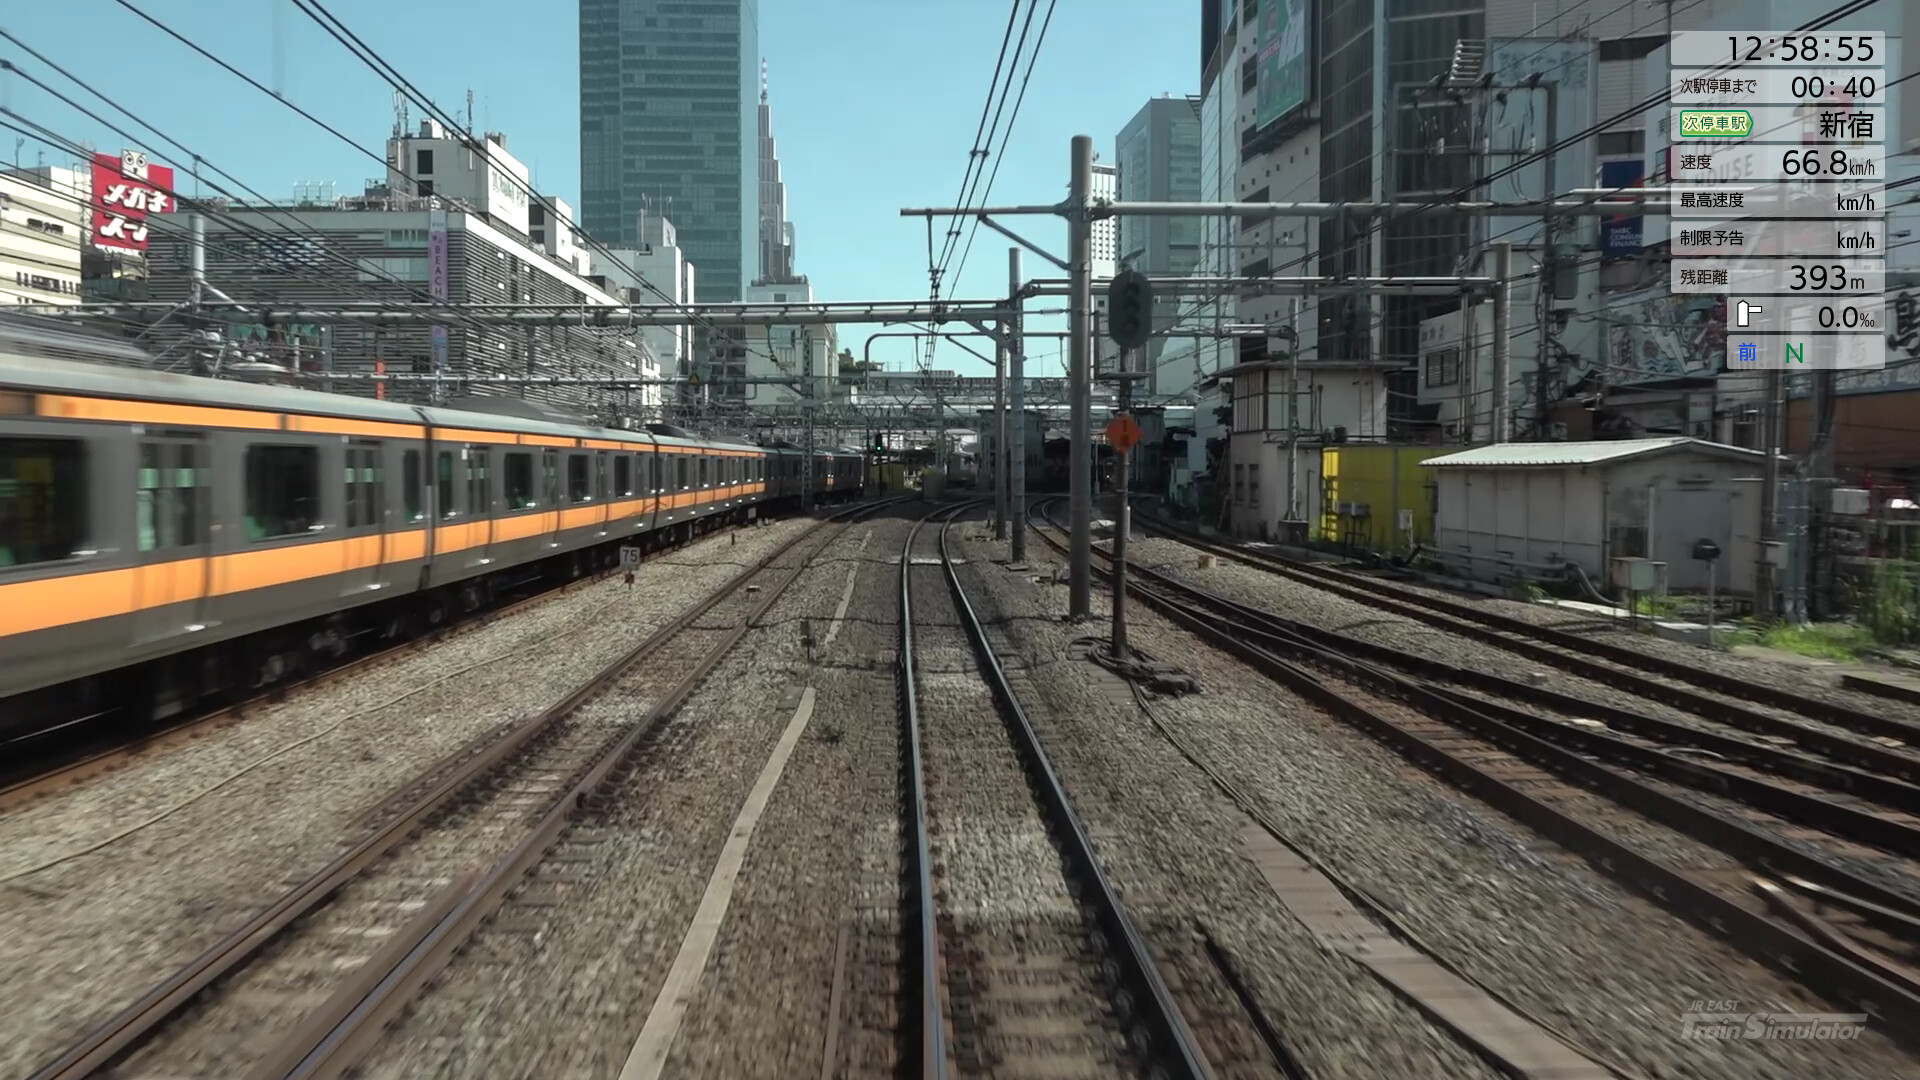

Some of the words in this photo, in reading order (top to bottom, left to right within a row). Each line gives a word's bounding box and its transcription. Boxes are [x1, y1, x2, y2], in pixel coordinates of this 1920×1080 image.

[103, 184, 168, 212] メガネ
[434, 245, 443, 296] BEACH
[622, 549, 638, 562] 75
